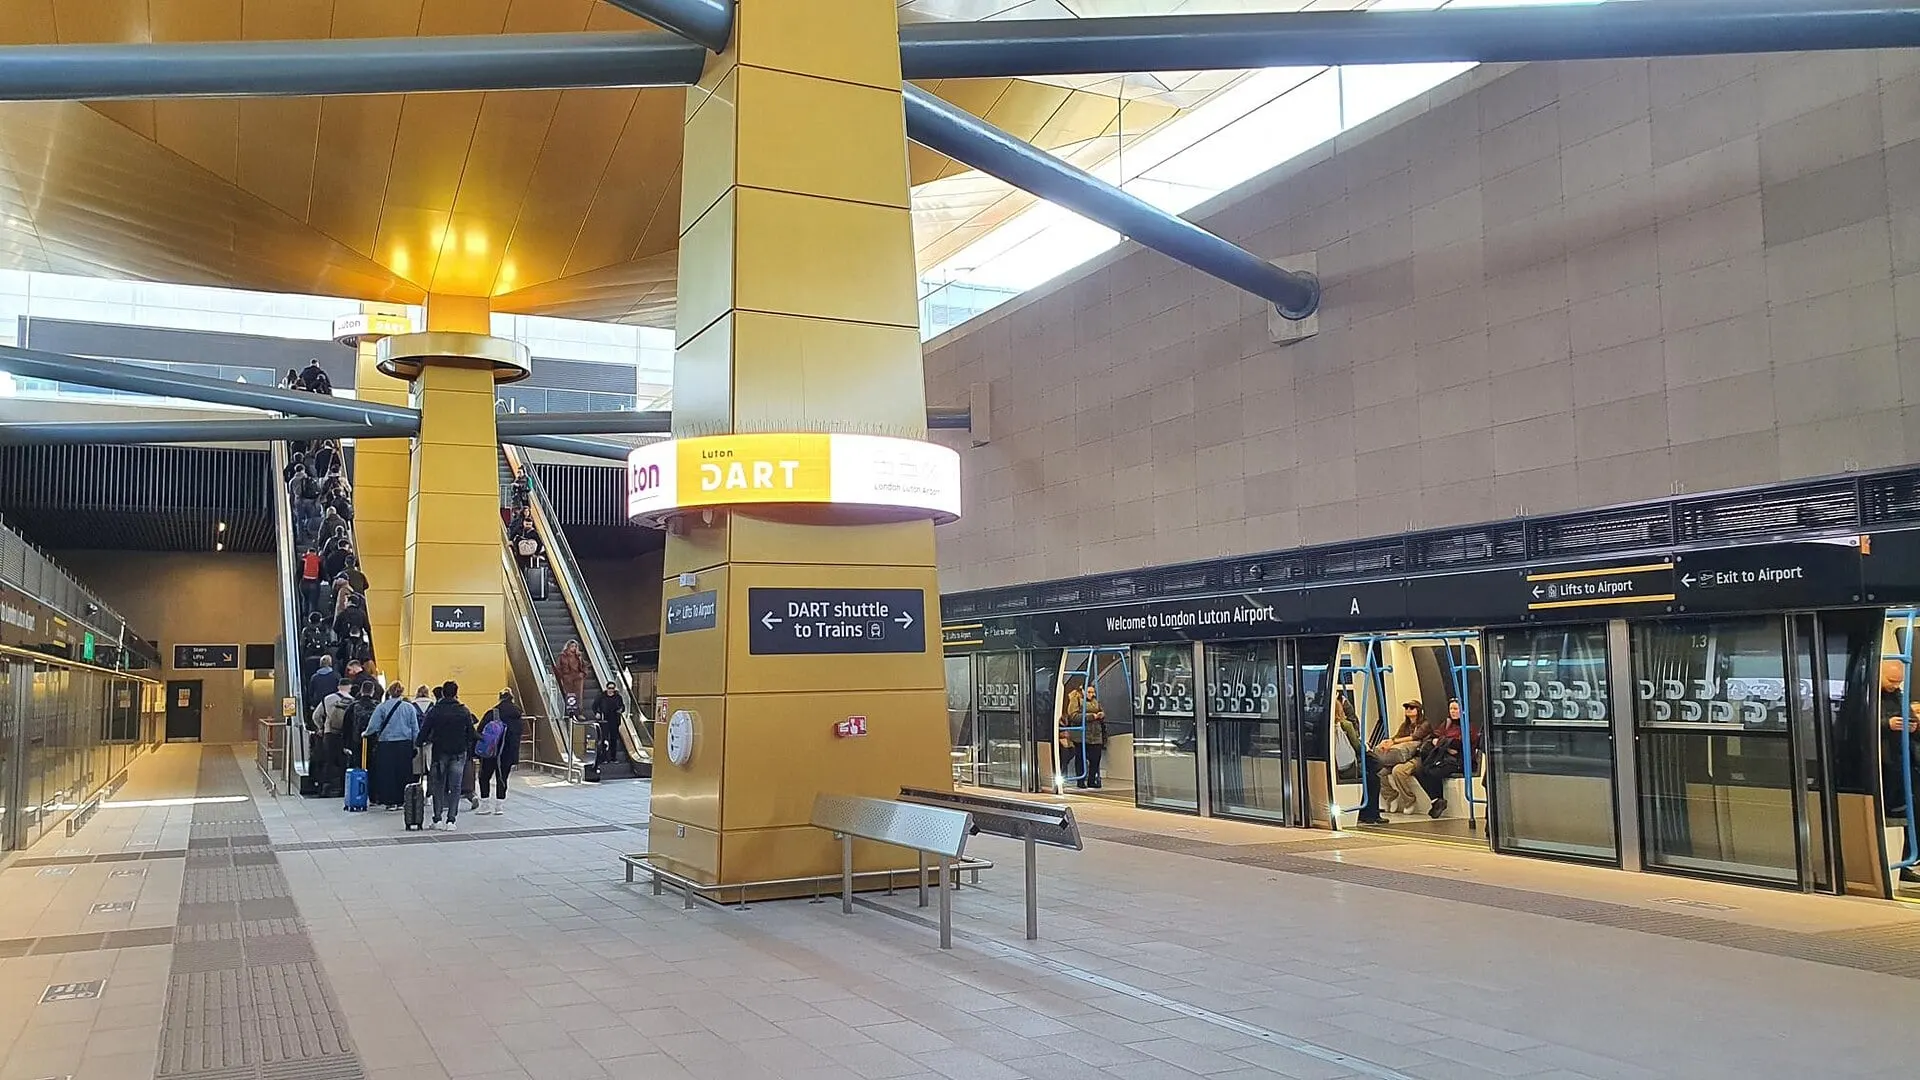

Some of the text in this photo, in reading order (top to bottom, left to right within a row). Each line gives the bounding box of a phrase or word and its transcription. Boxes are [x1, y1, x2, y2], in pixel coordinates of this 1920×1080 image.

[702, 450, 733, 459] Luton
[700, 460, 800, 491] DART
[1716, 566, 1803, 585] Exit to Airport
[1560, 580, 1633, 596] Lifts to Airport
[788, 601, 889, 618] DART shuttle
[1350, 597, 1360, 615] A
[435, 620, 471, 630] To Airport
[1106, 605, 1275, 631] Welcome to London Luton Airport
[794, 621, 863, 638] to Trains
[1054, 621, 1061, 635] A
[1692, 635, 1707, 648] 1.3
